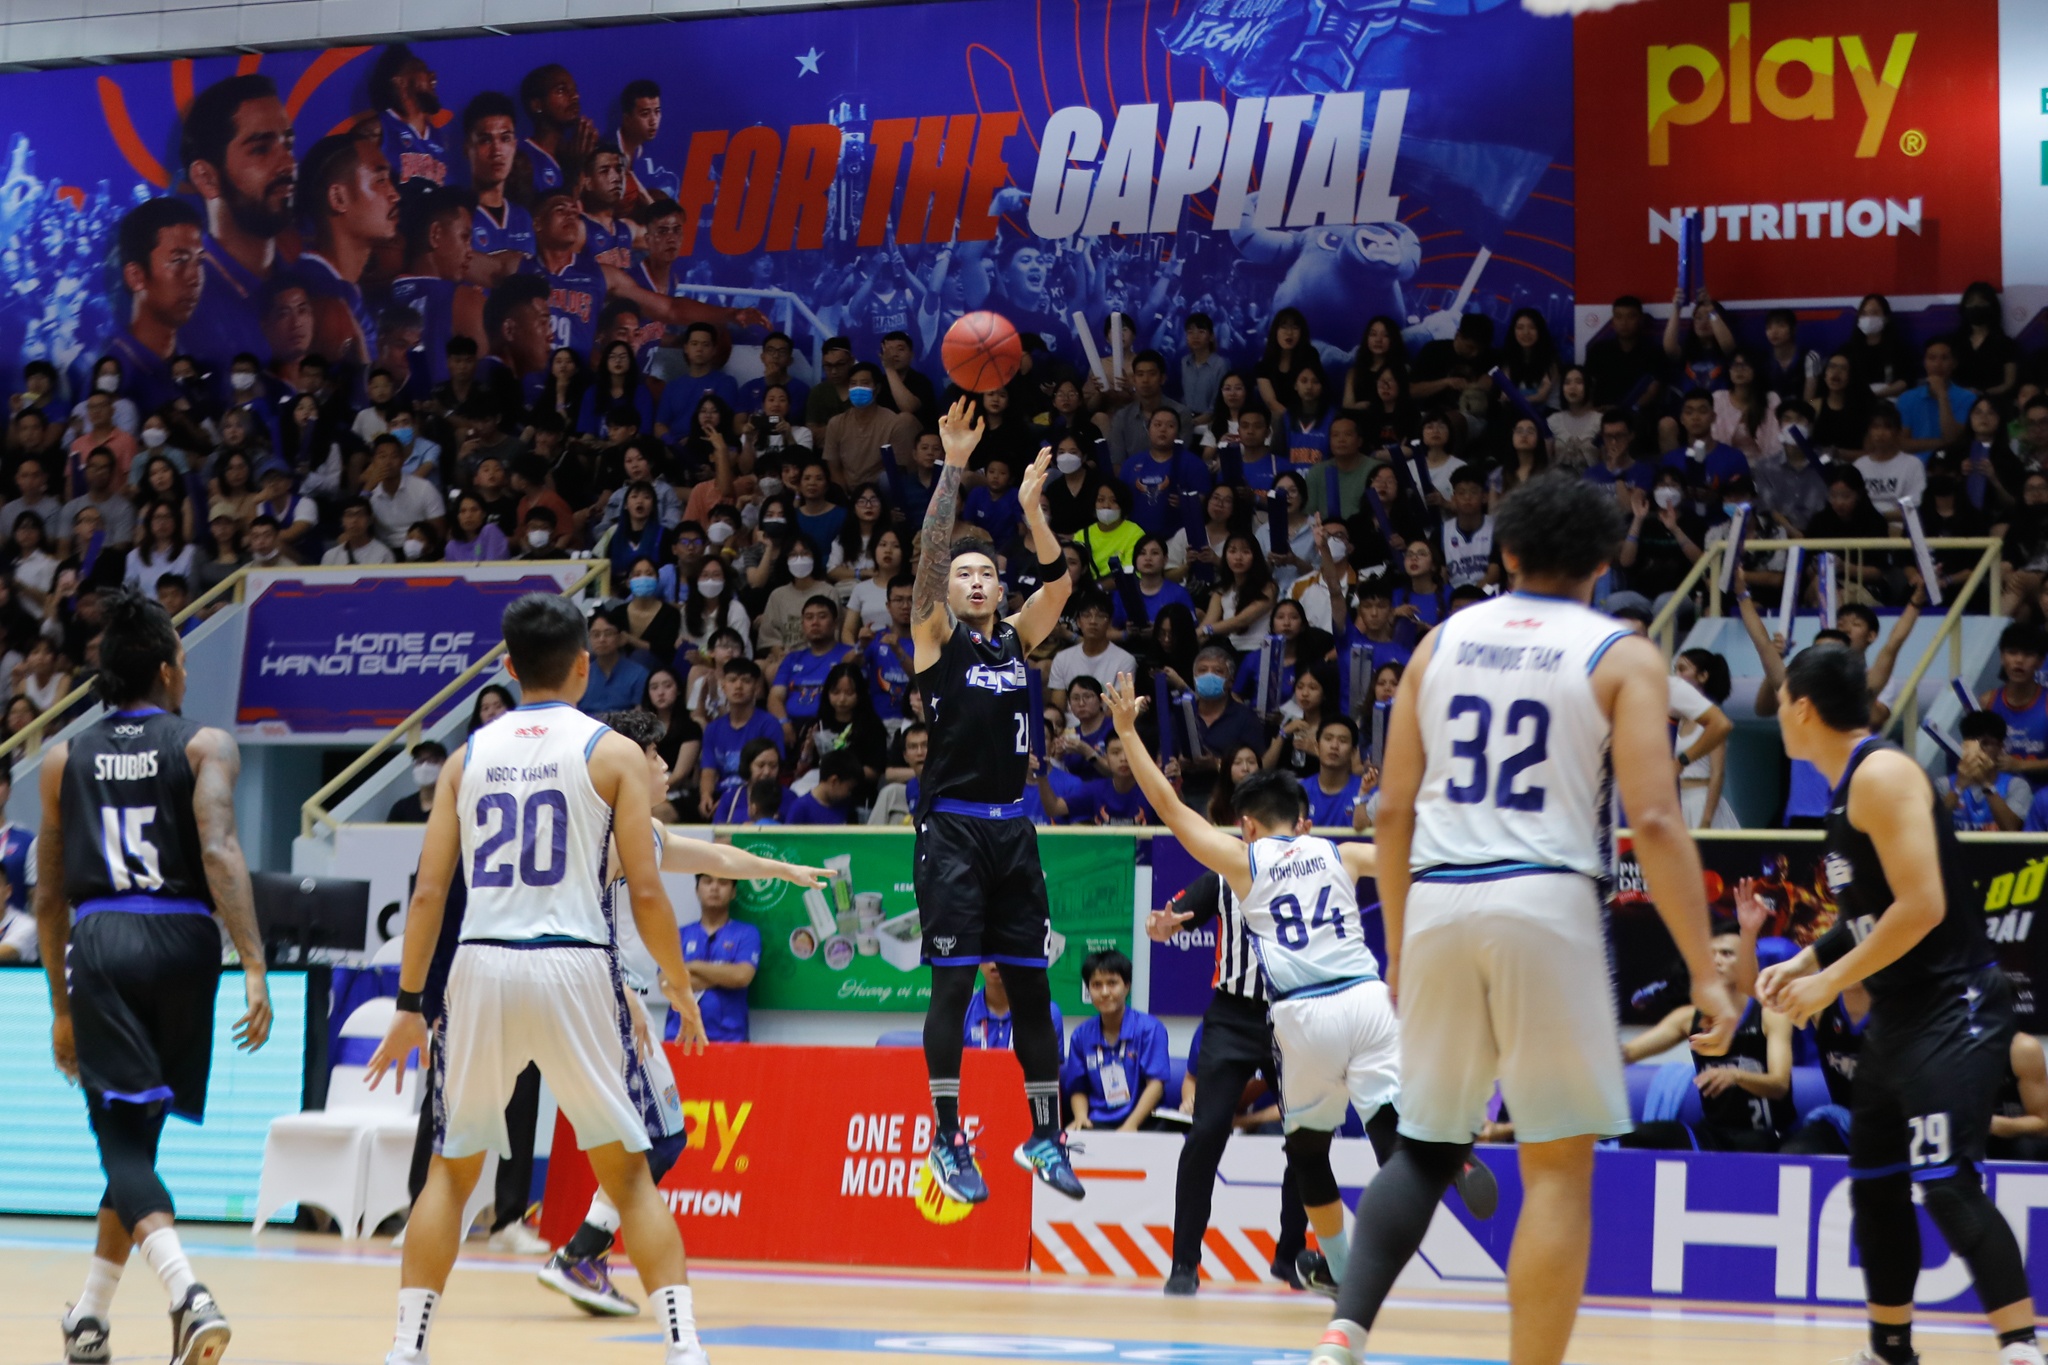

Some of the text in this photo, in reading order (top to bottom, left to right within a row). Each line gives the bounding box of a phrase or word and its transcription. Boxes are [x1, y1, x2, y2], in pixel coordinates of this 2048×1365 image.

[1647, 2, 1918, 166] play
[680, 88, 1410, 257] FOR THE CAPITAL
[1648, 197, 1923, 244] NUTRITION
[260, 653, 352, 676] HANOI
[335, 631, 475, 653] HOME OF
[94, 750, 159, 781] STUBBS
[1446, 694, 1551, 812] 32
[101, 806, 165, 891] 15
[471, 789, 568, 888] 20
[1269, 885, 1347, 952] 84
[681, 1100, 752, 1172] ay
[847, 1113, 980, 1155] ONE BE
[1908, 1111, 1951, 1167] 29
[658, 1189, 742, 1218] ITION
[840, 1157, 923, 1198] MORE
